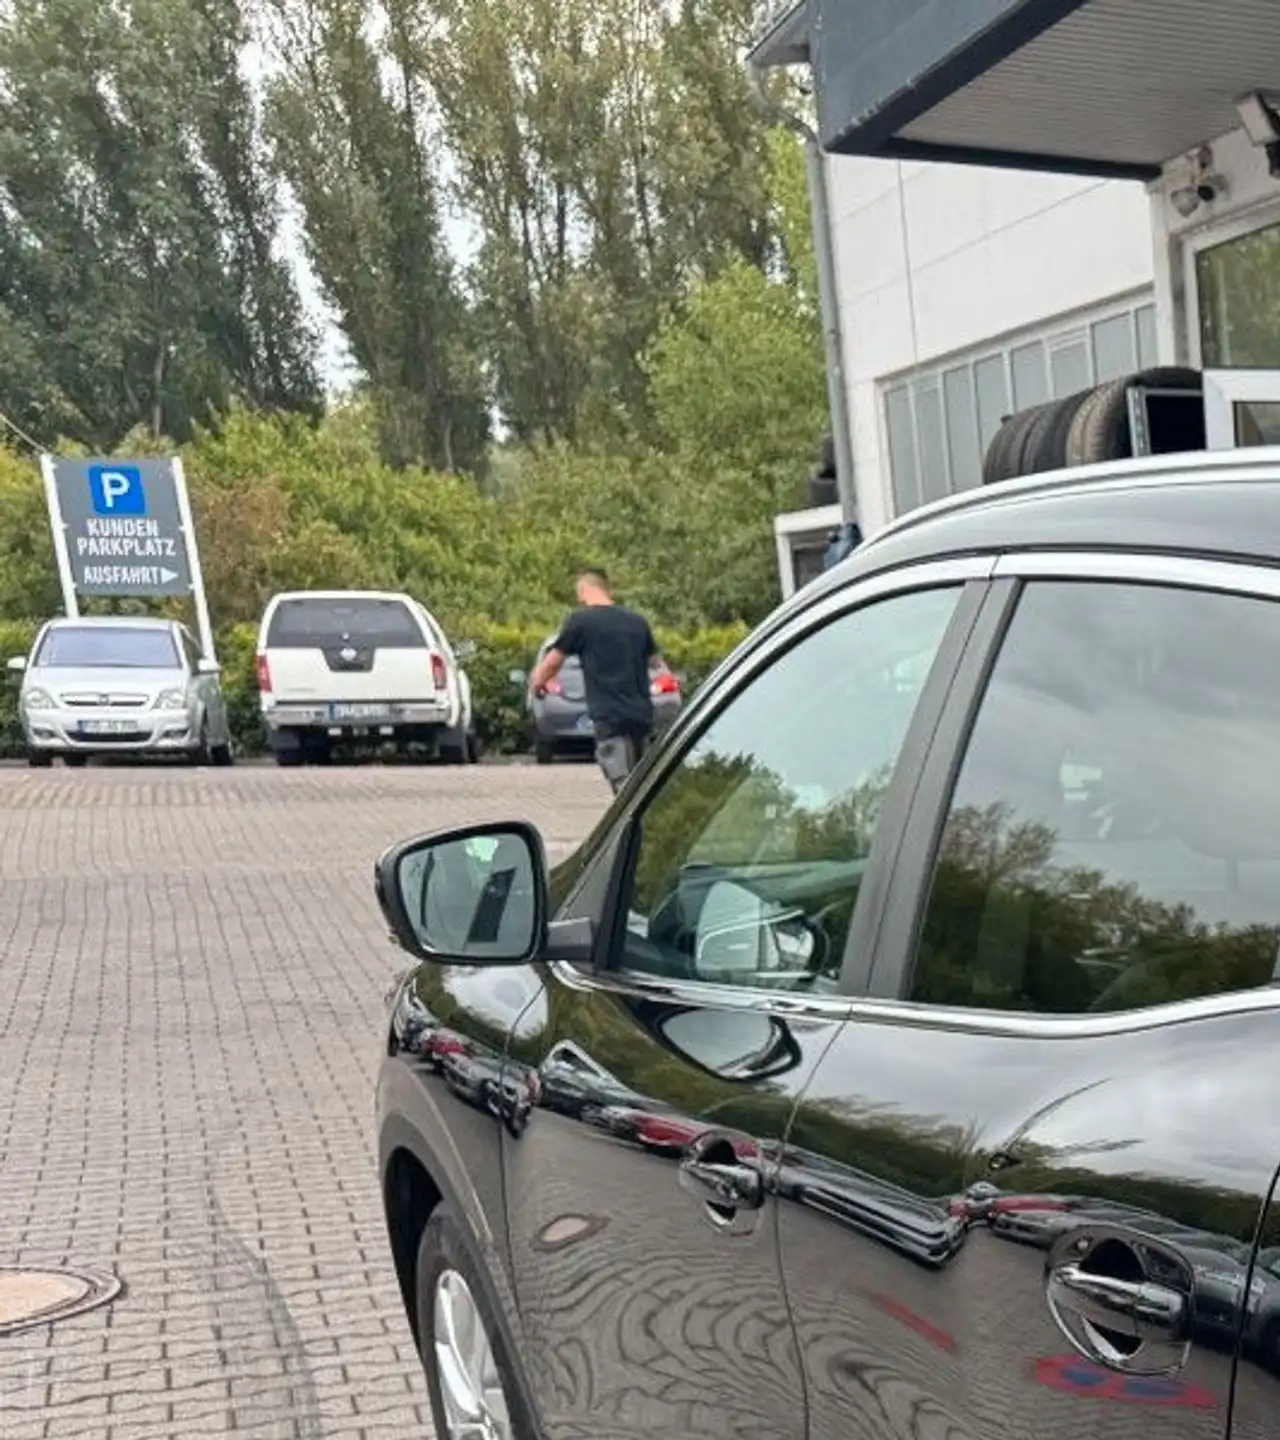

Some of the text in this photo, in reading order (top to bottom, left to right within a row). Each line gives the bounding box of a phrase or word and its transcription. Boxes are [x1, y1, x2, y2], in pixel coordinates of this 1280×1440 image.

[100, 472, 130, 508] P
[86, 518, 159, 537] KUNDEN
[76, 537, 177, 556] PARKPLATZ
[83, 565, 159, 584] AUSFAHRT
